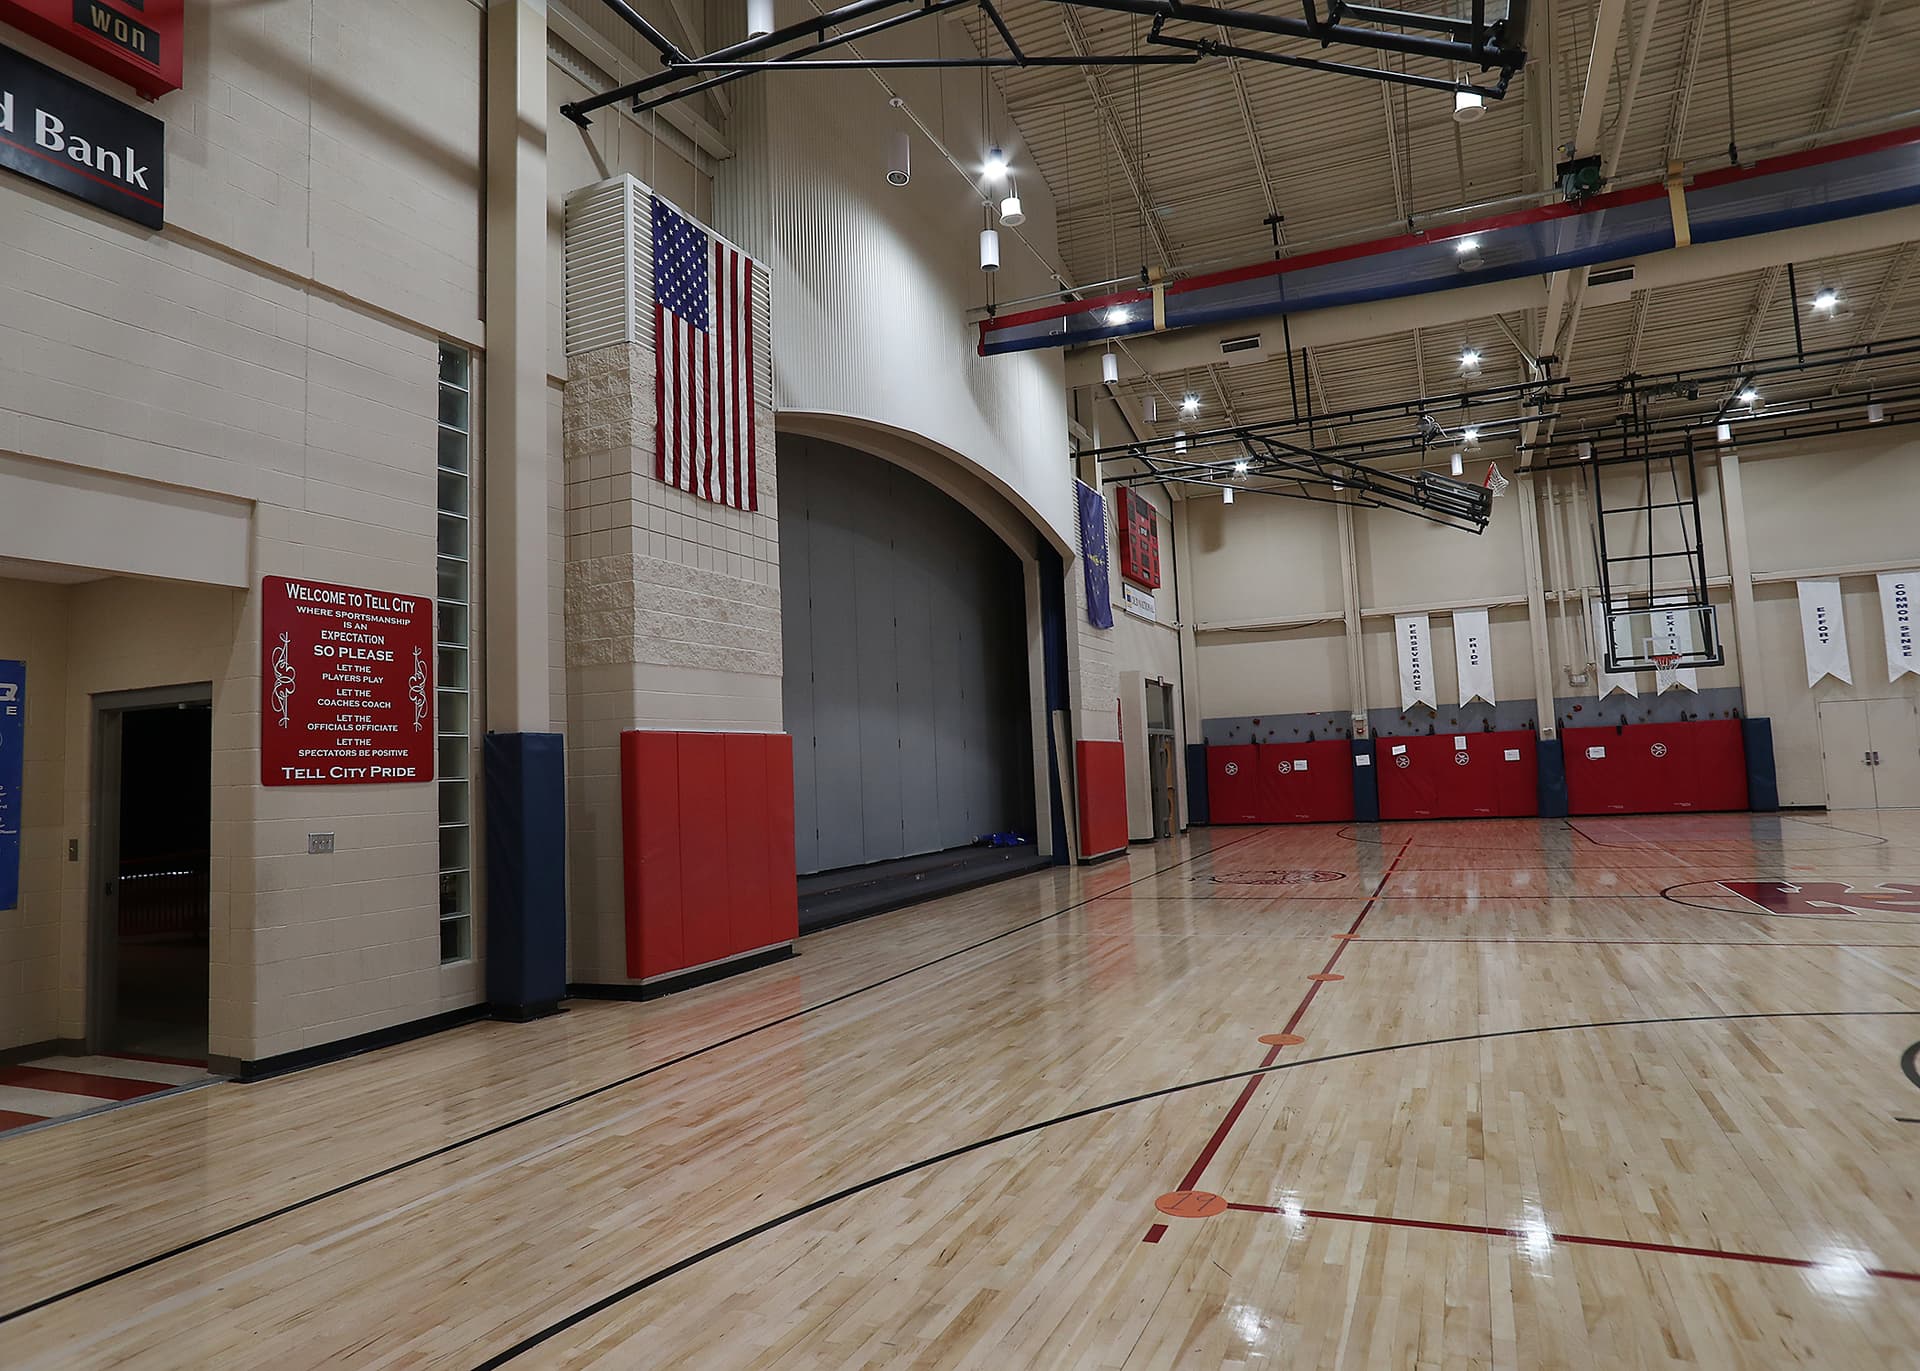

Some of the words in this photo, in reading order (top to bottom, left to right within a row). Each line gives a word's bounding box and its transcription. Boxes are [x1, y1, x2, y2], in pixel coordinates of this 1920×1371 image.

[35, 108, 149, 191] Bank
[285, 582, 346, 605] WELCOME
[348, 593, 362, 607] TO
[364, 593, 390, 610] TELL
[392, 597, 415, 614] CITY
[1895, 584, 1908, 621] COMMON
[296, 606, 333, 617] WHERE
[335, 611, 411, 625] SPORTSMANSHIP
[343, 621, 352, 629] IS
[354, 622, 367, 631] AN
[1816, 607, 1829, 643] EFFORT
[321, 630, 384, 645] EXPECTATION
[1900, 626, 1912, 656] SENSE
[314, 644, 335, 657] SO
[338, 646, 394, 662] PLEASE
[1409, 624, 1421, 691] PERSEVERANCE
[1469, 637, 1479, 666] PRIDE
[336, 664, 352, 672] LET
[355, 665, 371, 673] THE
[322, 673, 361, 682] PLAYERS
[363, 675, 384, 684] PLAY
[336, 688, 352, 696] LET
[355, 689, 371, 697] THE
[317, 698, 360, 708] COACHES
[361, 700, 391, 709] COACH
[336, 714, 352, 722] LET
[307, 723, 354, 731] OFFICIALS
[355, 724, 398, 732] OFFICIATE
[336, 738, 352, 746] LET
[355, 738, 371, 746] THE
[298, 749, 357, 757] SPECTATORS
[358, 749, 370, 757] BE
[372, 749, 408, 757] POSITIVE
[281, 767, 326, 779] TELL
[329, 766, 367, 778] CITY
[370, 766, 416, 777] PRIDE
